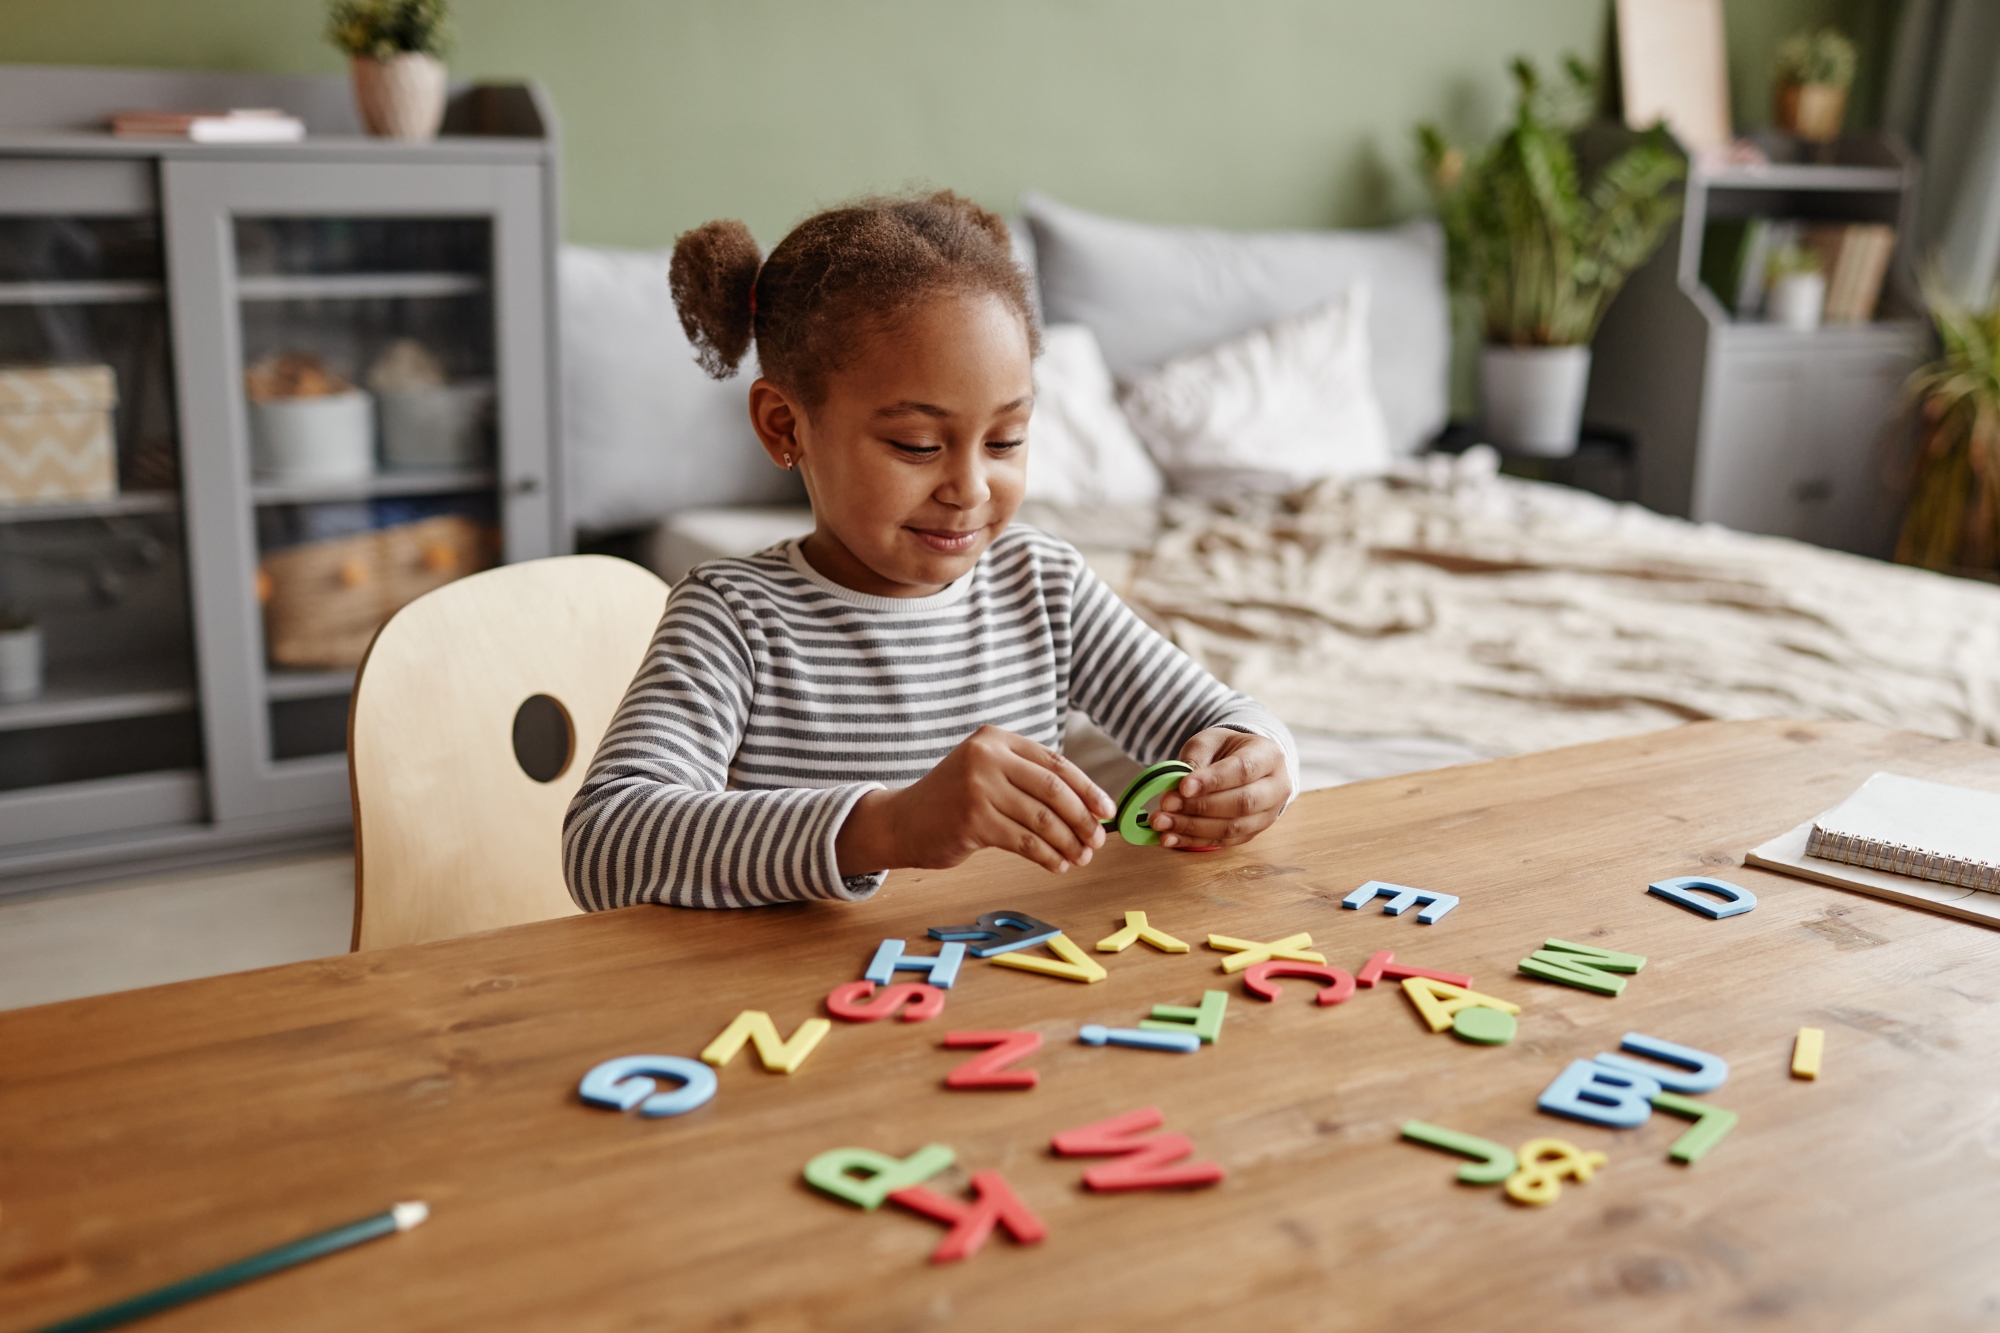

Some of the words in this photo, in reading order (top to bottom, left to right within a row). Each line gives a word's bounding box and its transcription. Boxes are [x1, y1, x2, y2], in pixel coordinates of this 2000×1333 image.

[1342, 880, 1460, 925] E
[1648, 876, 1757, 919] D
[990, 933, 1108, 983] V
[1096, 911, 1190, 953] Y
[1207, 931, 1328, 973] X
[865, 939, 967, 989] H
[1243, 960, 1356, 1006] C
[1356, 950, 1473, 990] T
[827, 981, 945, 1022] S
[1137, 989, 1229, 1044] F
[1401, 976, 1522, 1032] A
[700, 1010, 831, 1073] N
[944, 1031, 1042, 1089] Z
[1593, 1032, 1729, 1093] U
[579, 1054, 717, 1117] G
[1538, 1058, 1661, 1128] B
[1400, 1119, 1518, 1185] J
[1651, 1092, 1739, 1163] L
[804, 1143, 956, 1211] P
[1506, 1137, 1607, 1206] &
[886, 1170, 1048, 1264] K
